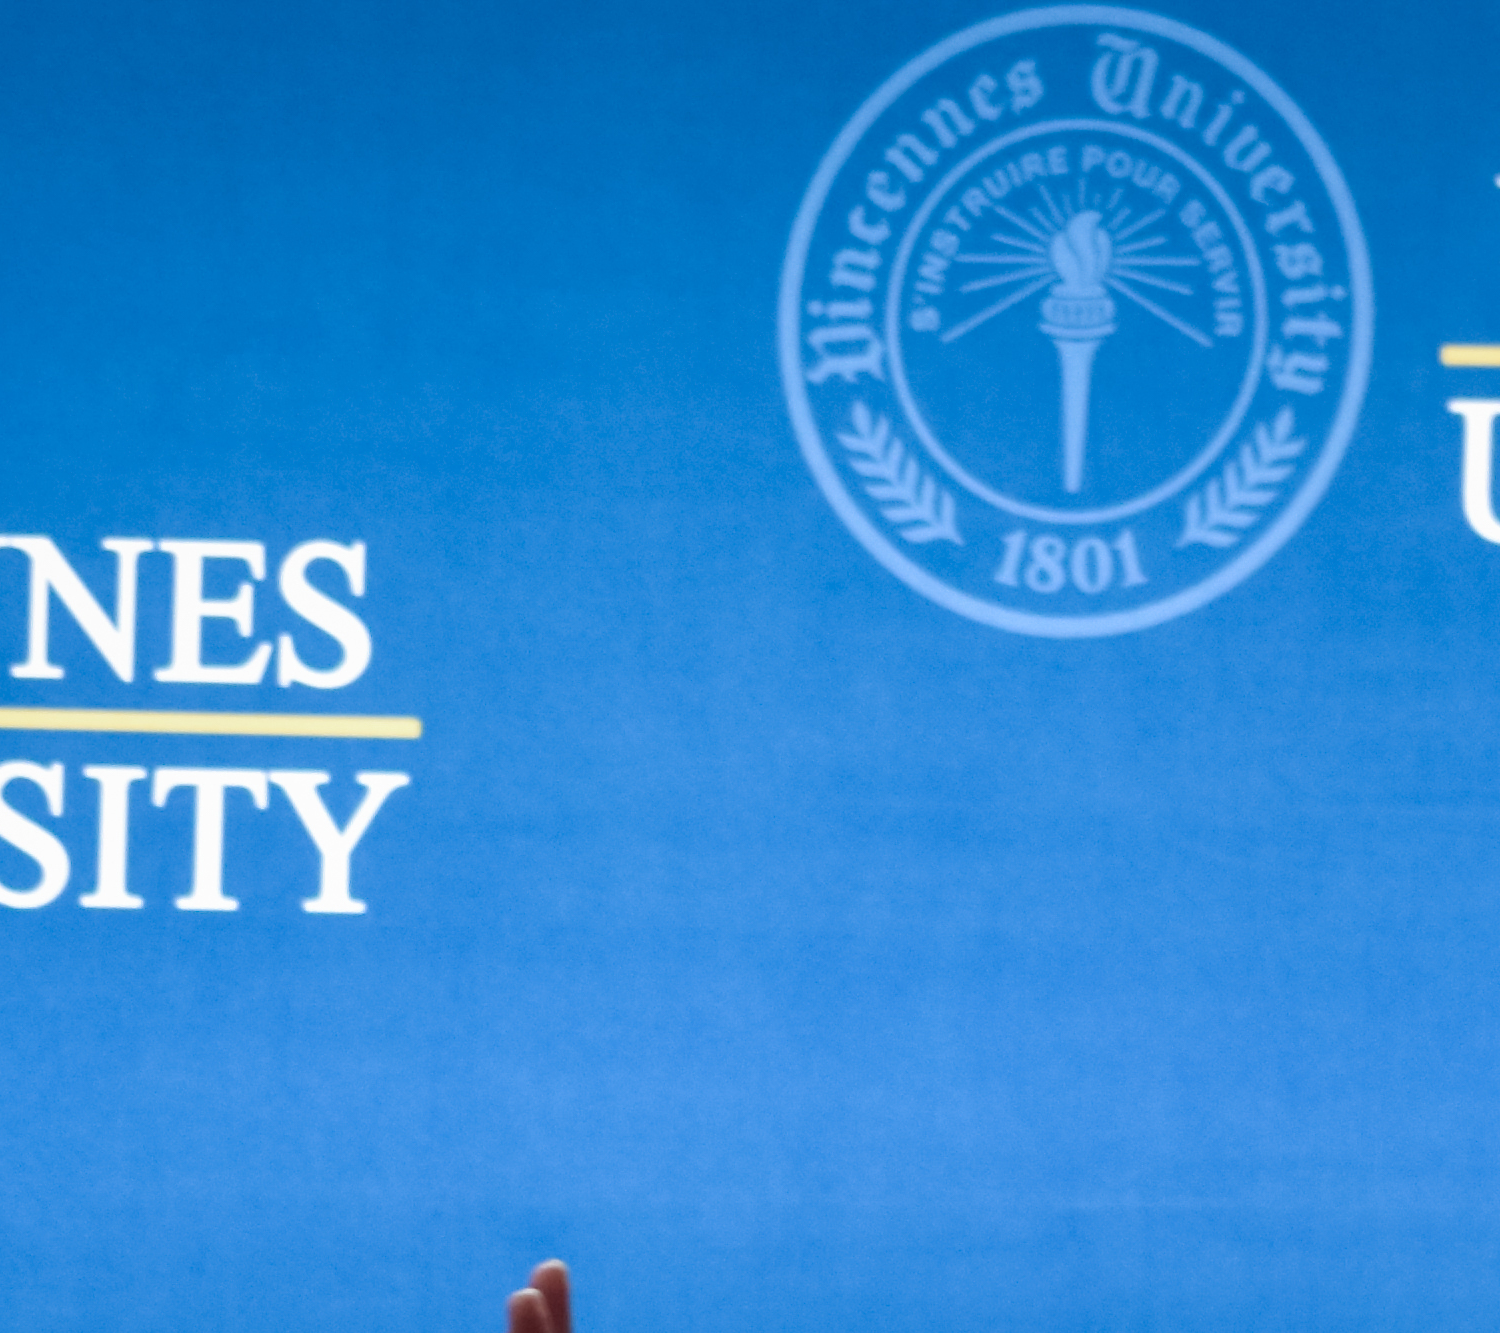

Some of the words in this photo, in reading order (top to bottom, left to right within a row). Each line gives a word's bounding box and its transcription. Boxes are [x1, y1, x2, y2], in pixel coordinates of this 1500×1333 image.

[1081, 144, 1182, 203] POUR
[805, 58, 1045, 384] Vincennes
[1090, 33, 1347, 395] University
[994, 529, 1149, 594] 1801
